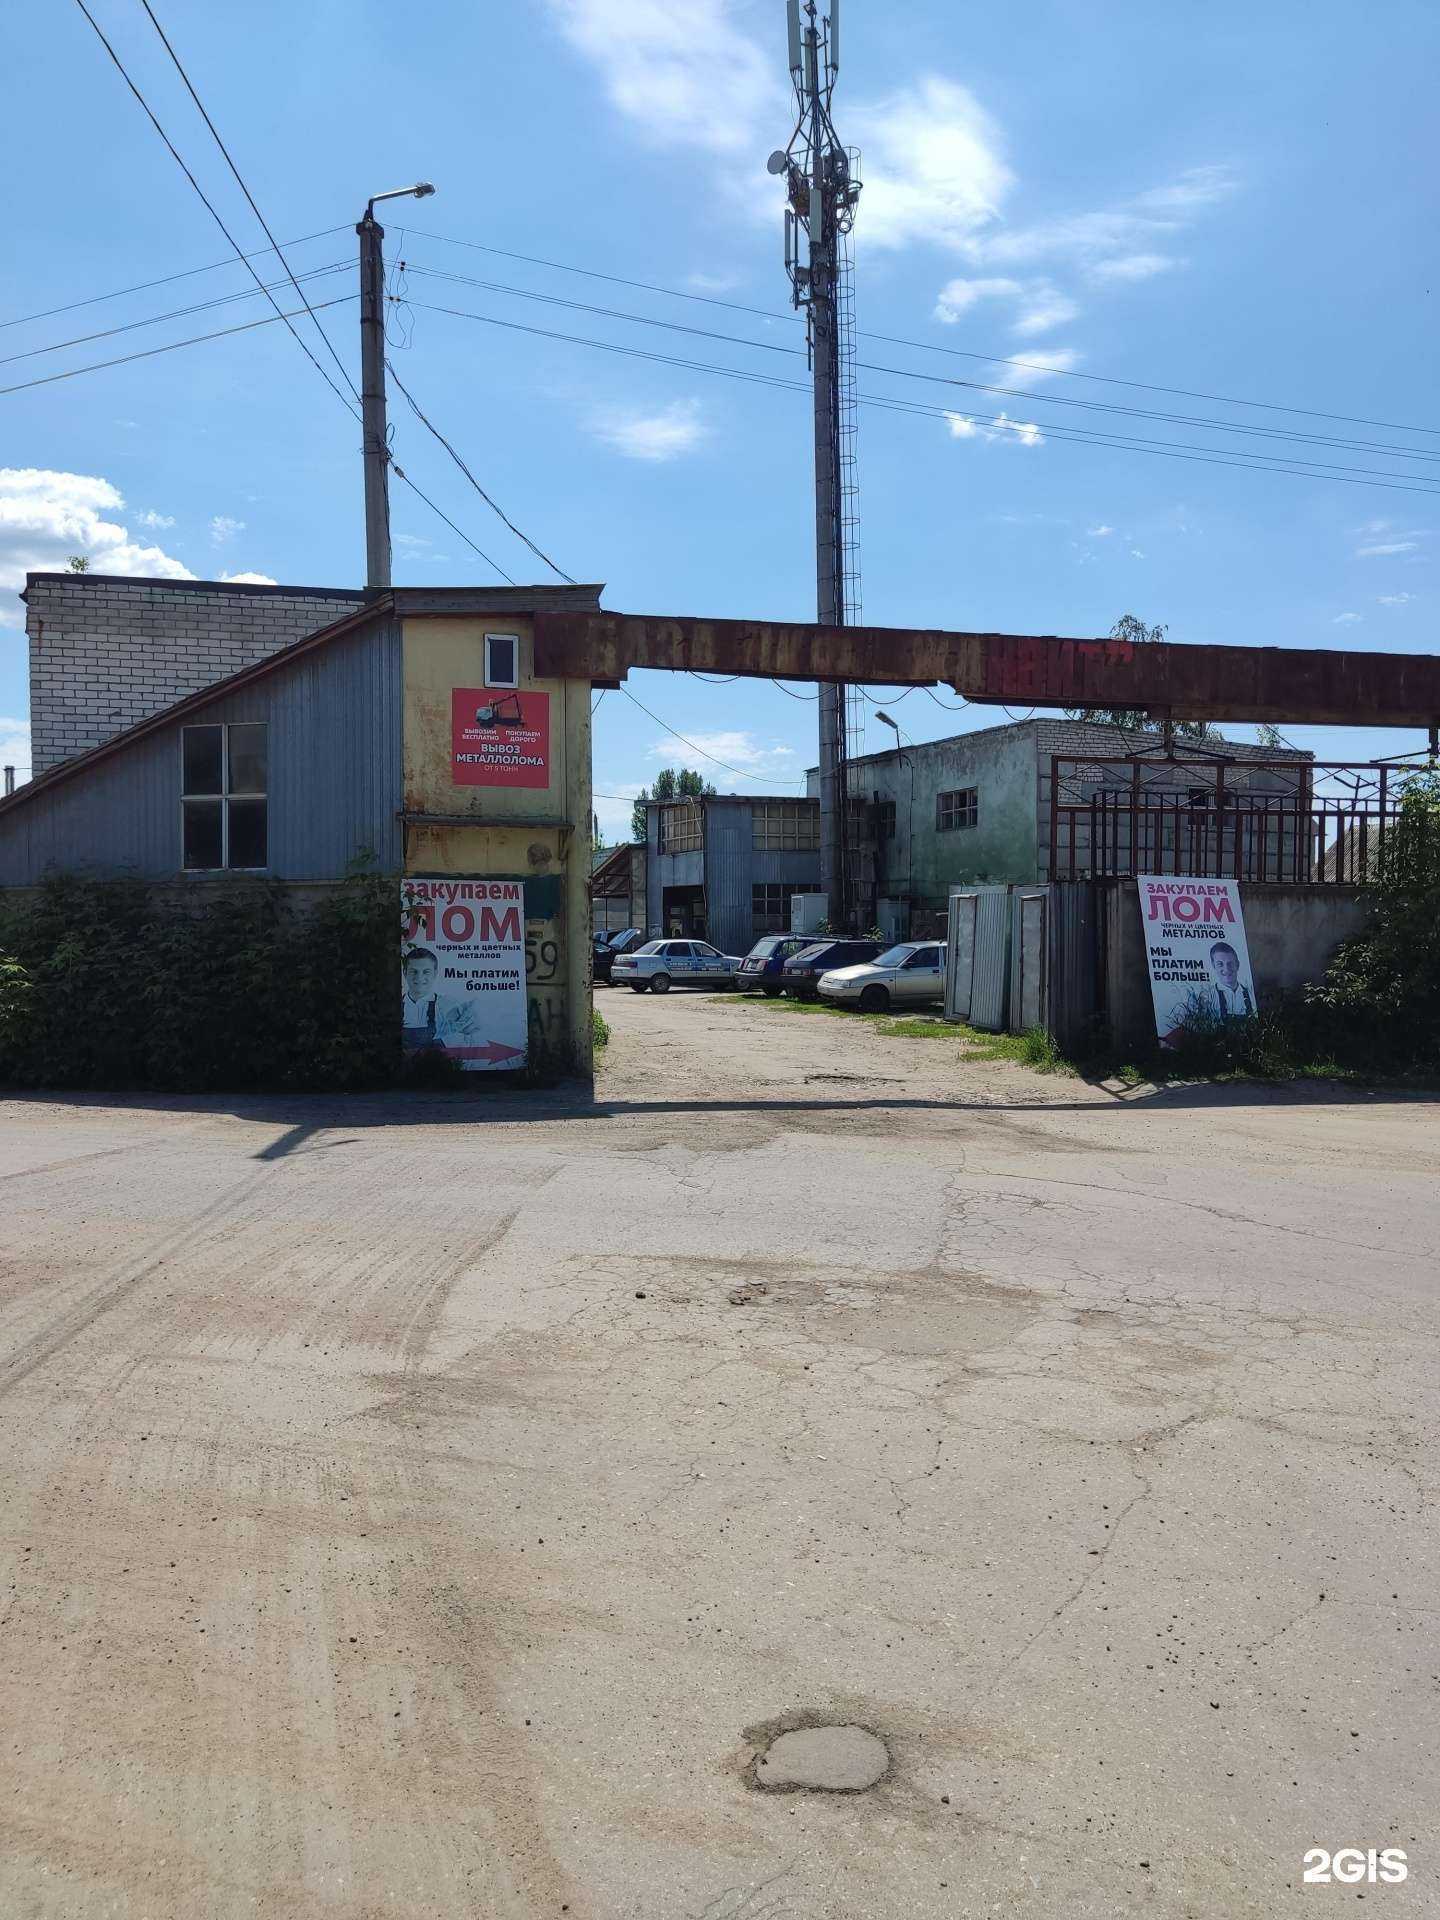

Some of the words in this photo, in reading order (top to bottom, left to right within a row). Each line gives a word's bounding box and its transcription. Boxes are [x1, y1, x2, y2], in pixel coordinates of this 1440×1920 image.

[481, 743, 521, 754] ВЫВОЗ
[456, 753, 545, 766] МЕТАЛЛОЛОМА
[1146, 882, 1228, 896] ЗАКУПАЕМ
[1148, 895, 1236, 923] ЛОМ
[401, 905, 522, 942] ЛОМ
[1162, 929, 1226, 939] МЕТАЛЛОВ
[436, 944, 472, 952] черных
[481, 944, 521, 952] цветных
[1150, 946, 1172, 957] МЫ
[1152, 959, 1204, 969] ПЛАТИМ
[444, 967, 468, 978] Мы
[471, 968, 520, 979] платим
[1153, 971, 1210, 982] БОЛЬШЕ!
[466, 980, 520, 991] больше!
